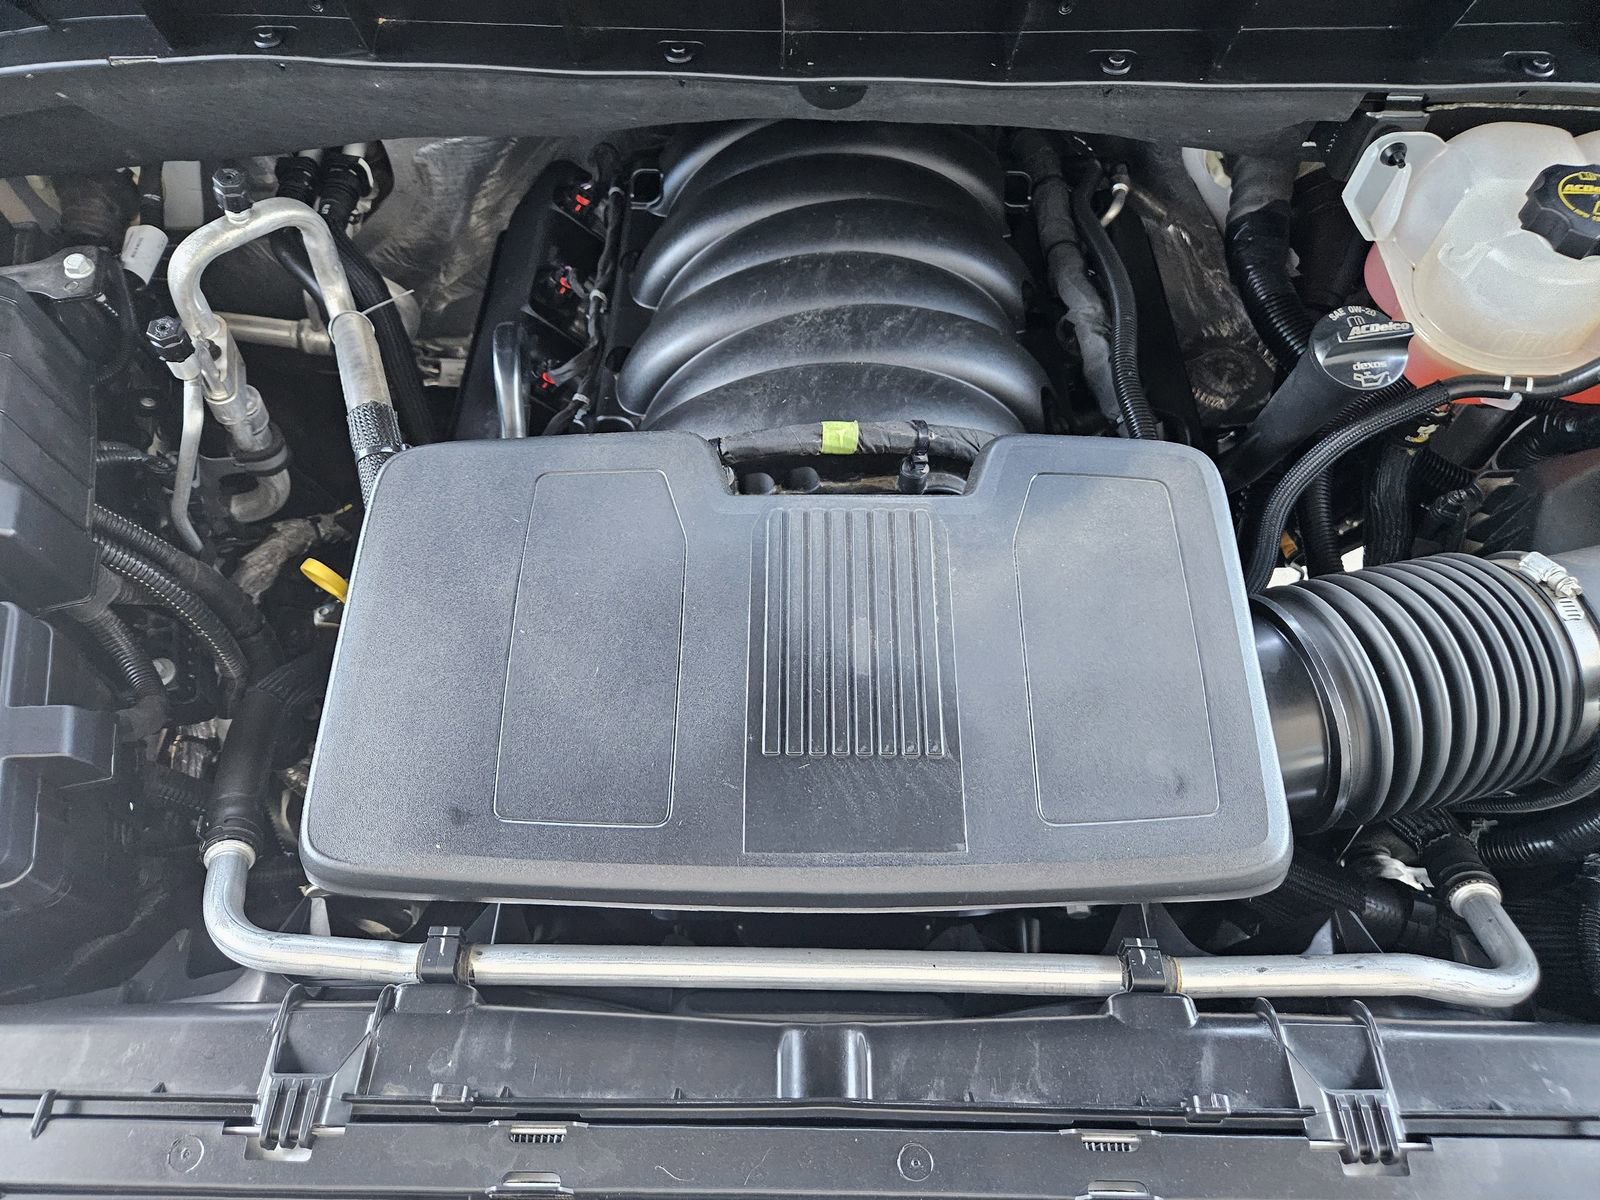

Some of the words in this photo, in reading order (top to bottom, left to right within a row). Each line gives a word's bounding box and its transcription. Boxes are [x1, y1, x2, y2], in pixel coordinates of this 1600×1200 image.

[1329, 308, 1346, 321] SAE
[1348, 305, 1376, 317] 0W-20
[1349, 322, 1410, 336] ACDelco
[1353, 361, 1388, 371] dexos
